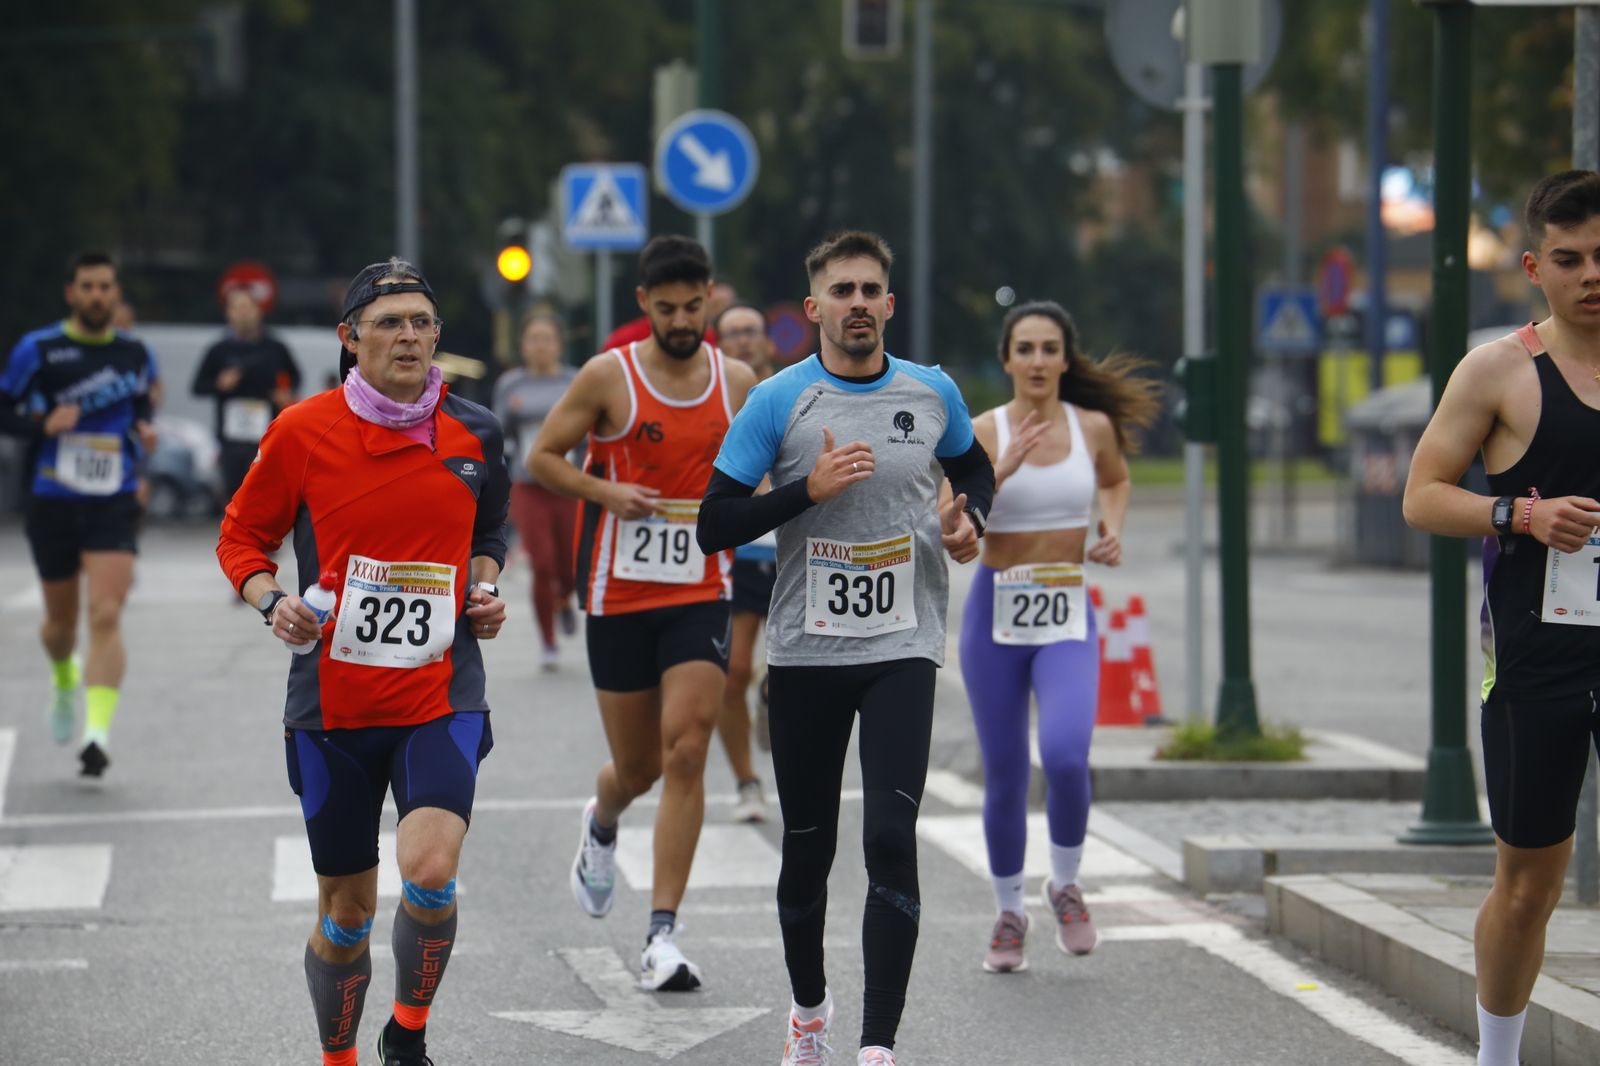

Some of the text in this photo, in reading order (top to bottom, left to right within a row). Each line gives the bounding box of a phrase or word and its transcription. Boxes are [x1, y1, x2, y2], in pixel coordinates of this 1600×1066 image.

[634, 526, 689, 566] 219
[811, 542, 851, 561] XXXIX
[352, 559, 390, 583] XXXIX
[403, 587, 450, 596] TRINITARIOS
[828, 571, 895, 619] 330
[1012, 591, 1069, 628] 220
[355, 596, 432, 646] 323
